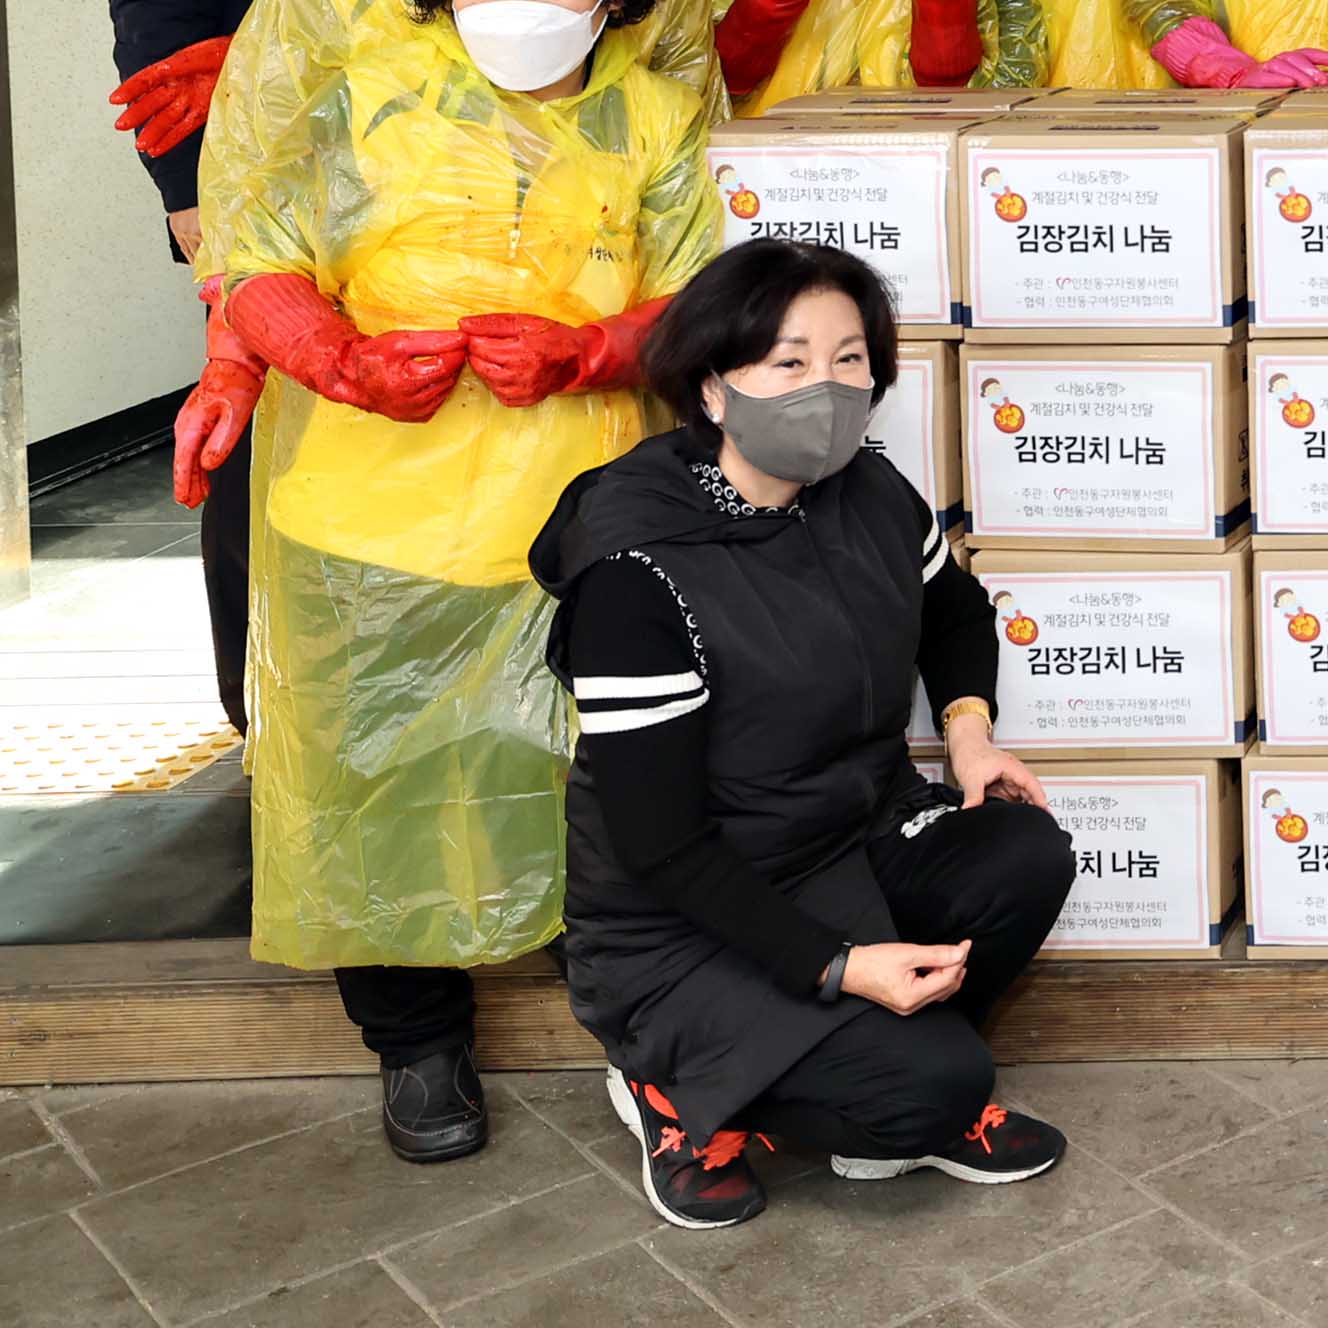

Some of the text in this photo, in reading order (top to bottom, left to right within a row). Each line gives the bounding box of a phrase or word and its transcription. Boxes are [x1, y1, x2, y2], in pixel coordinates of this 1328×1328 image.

[764, 187, 811, 203] 계절김치
[826, 187, 862, 203] 건강식
[866, 186, 888, 202] 전달
[854, 221, 901, 250] 나눔
[1016, 224, 1172, 253] 김장김치 나눔
[1014, 435, 1166, 465] 김장김치 나눔
[1027, 645, 1185, 676] 김장김치 나눔
[1111, 850, 1161, 879] 나눔
[1055, 917, 1163, 931] 천동구여성단체협의회
